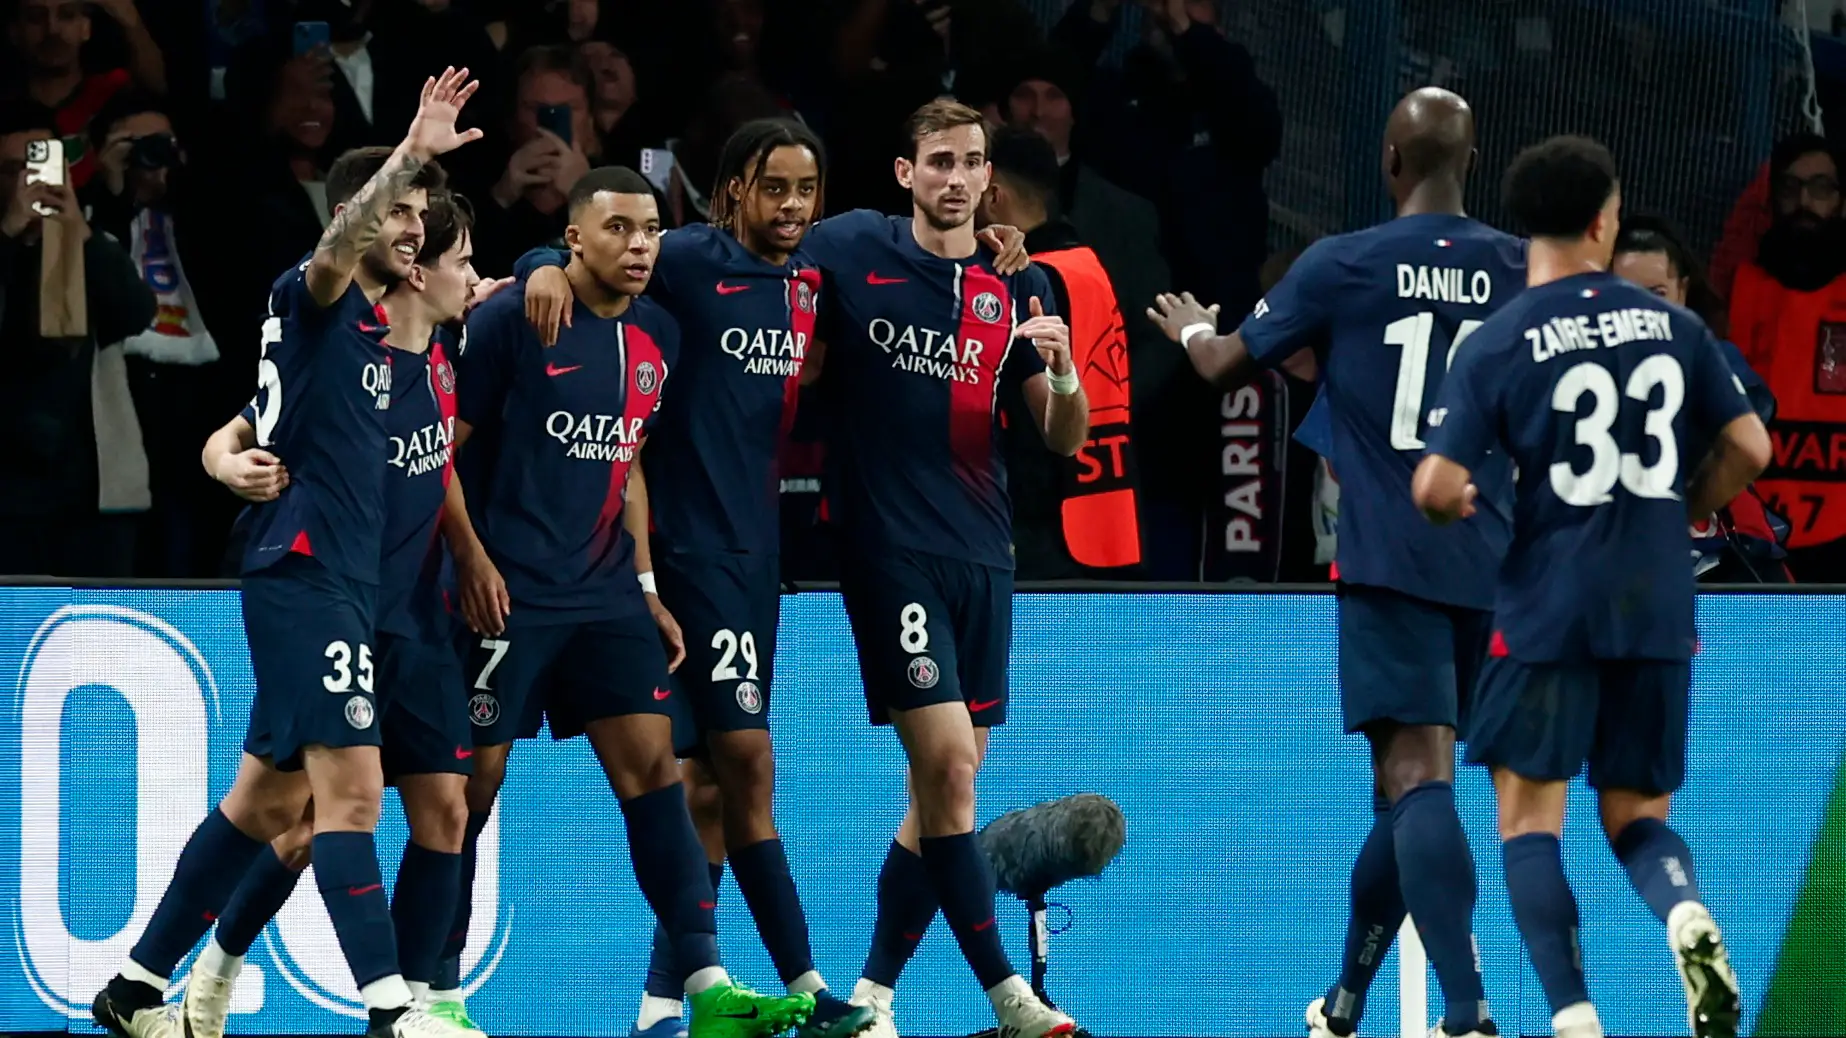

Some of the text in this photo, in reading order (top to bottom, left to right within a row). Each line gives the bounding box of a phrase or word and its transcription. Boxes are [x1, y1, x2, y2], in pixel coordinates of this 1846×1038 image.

[1396, 263, 1492, 305] DANILO
[720, 327, 806, 361] QATAR
[868, 317, 984, 367] QATAR
[1524, 307, 1674, 363] ZAÏRE-EMERY
[891, 352, 980, 385] AIRWAYS
[545, 410, 644, 444] QATAR
[1550, 353, 1686, 507] 33
[1220, 383, 1262, 552] PARIS
[900, 602, 930, 654] 8
[322, 640, 374, 694] 35
[473, 639, 511, 691] 7
[710, 628, 760, 682] 29
